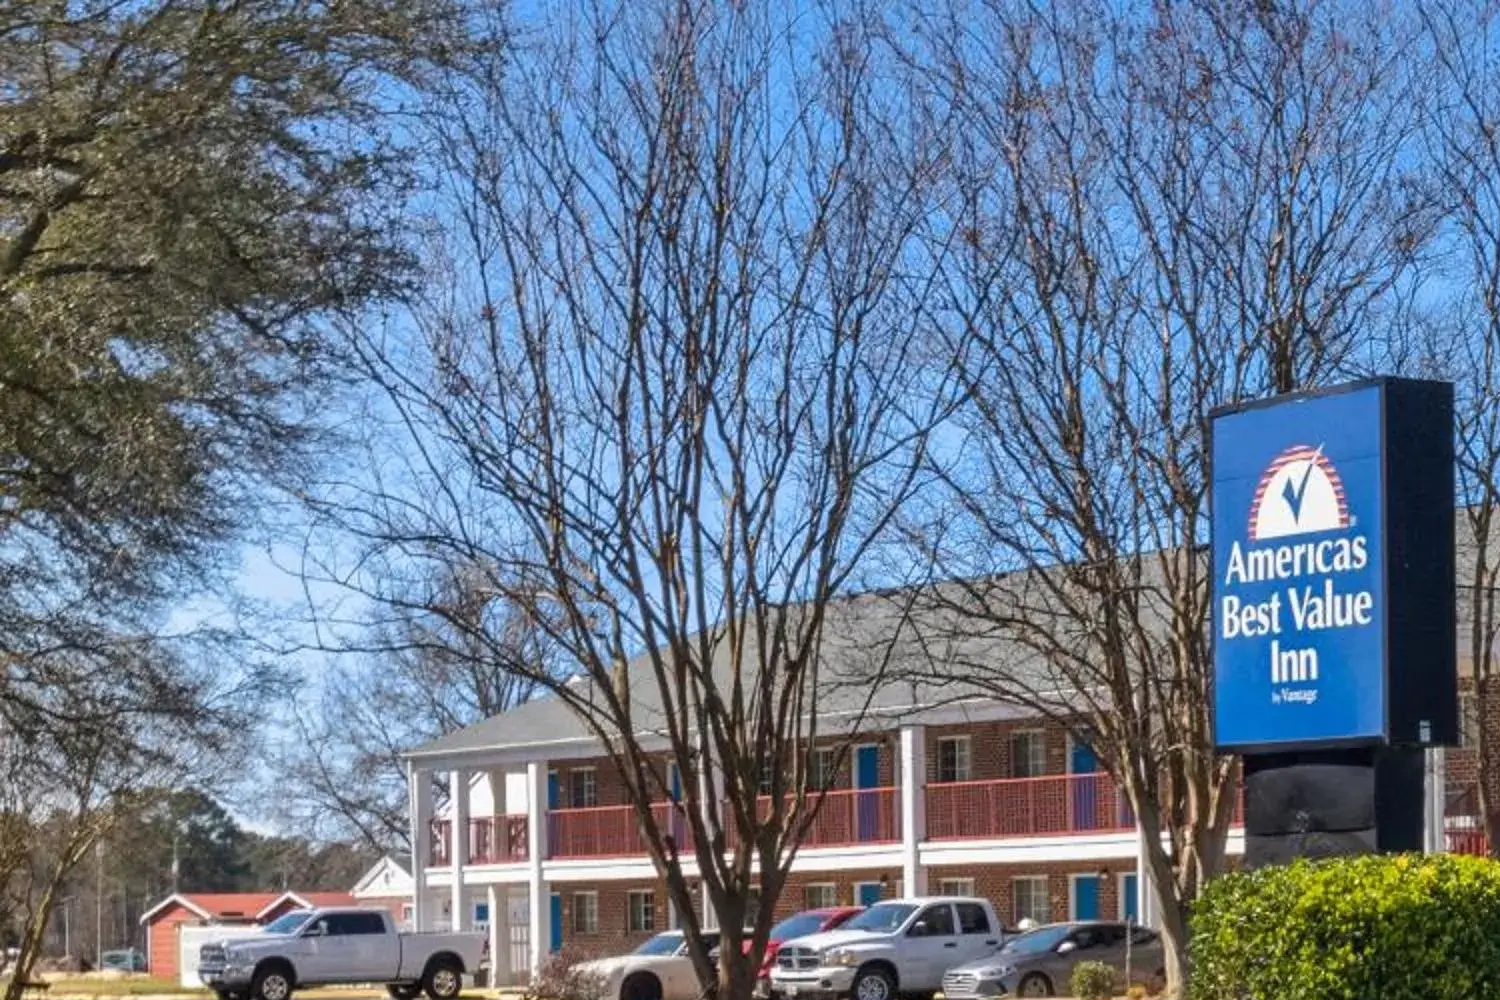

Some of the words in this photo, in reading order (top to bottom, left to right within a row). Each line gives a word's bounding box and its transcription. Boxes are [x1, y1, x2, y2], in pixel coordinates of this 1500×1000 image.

[1225, 535, 1367, 585] Americas
[1222, 591, 1281, 639] Best
[1287, 578, 1373, 631] Value
[1271, 639, 1319, 684] Inn
